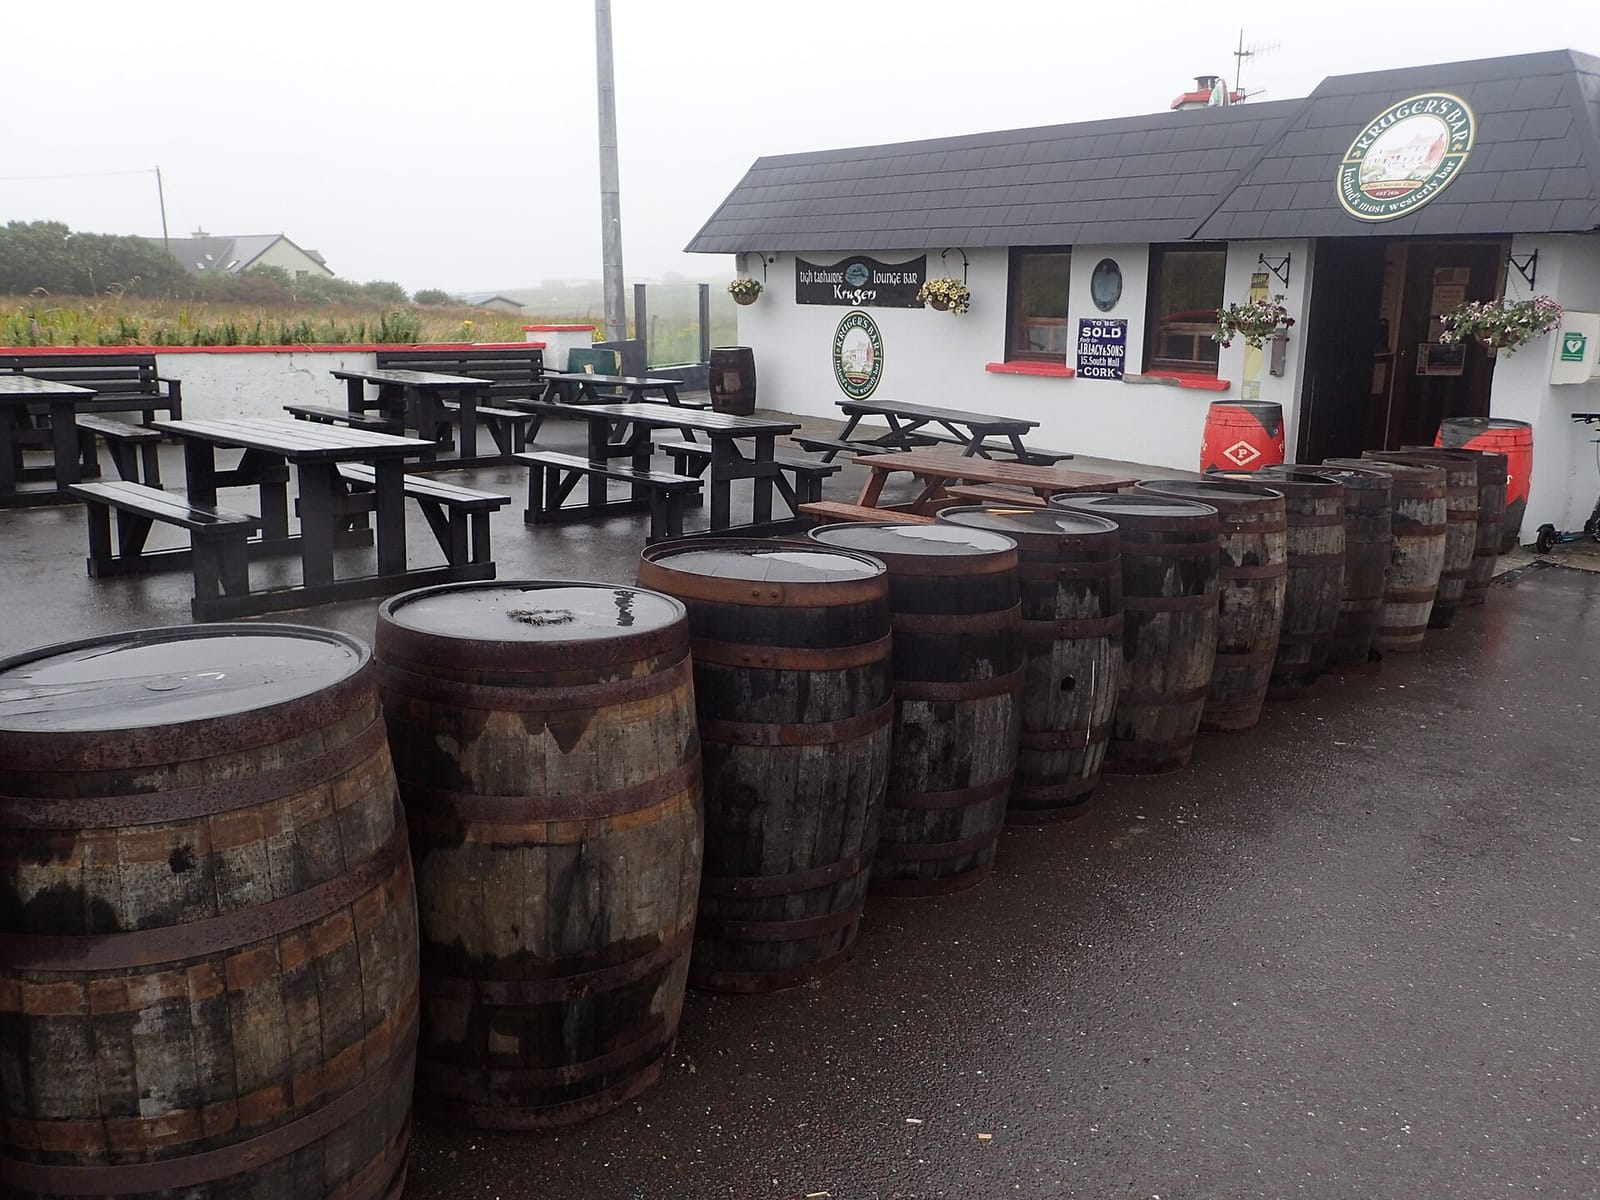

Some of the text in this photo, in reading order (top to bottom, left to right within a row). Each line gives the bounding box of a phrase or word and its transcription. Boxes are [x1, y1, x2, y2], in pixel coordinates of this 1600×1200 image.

[1356, 99, 1469, 149] KRUGER'S BAR
[1343, 160, 1456, 213] Ireland's most westerly bar
[903, 272, 918, 284] BAR
[833, 284, 877, 306] Krugers
[836, 316, 880, 350] KRUGER'S BAR
[1082, 327, 1122, 338] SOLD
[1083, 366, 1116, 378] CORK
[1237, 449, 1248, 459] P
